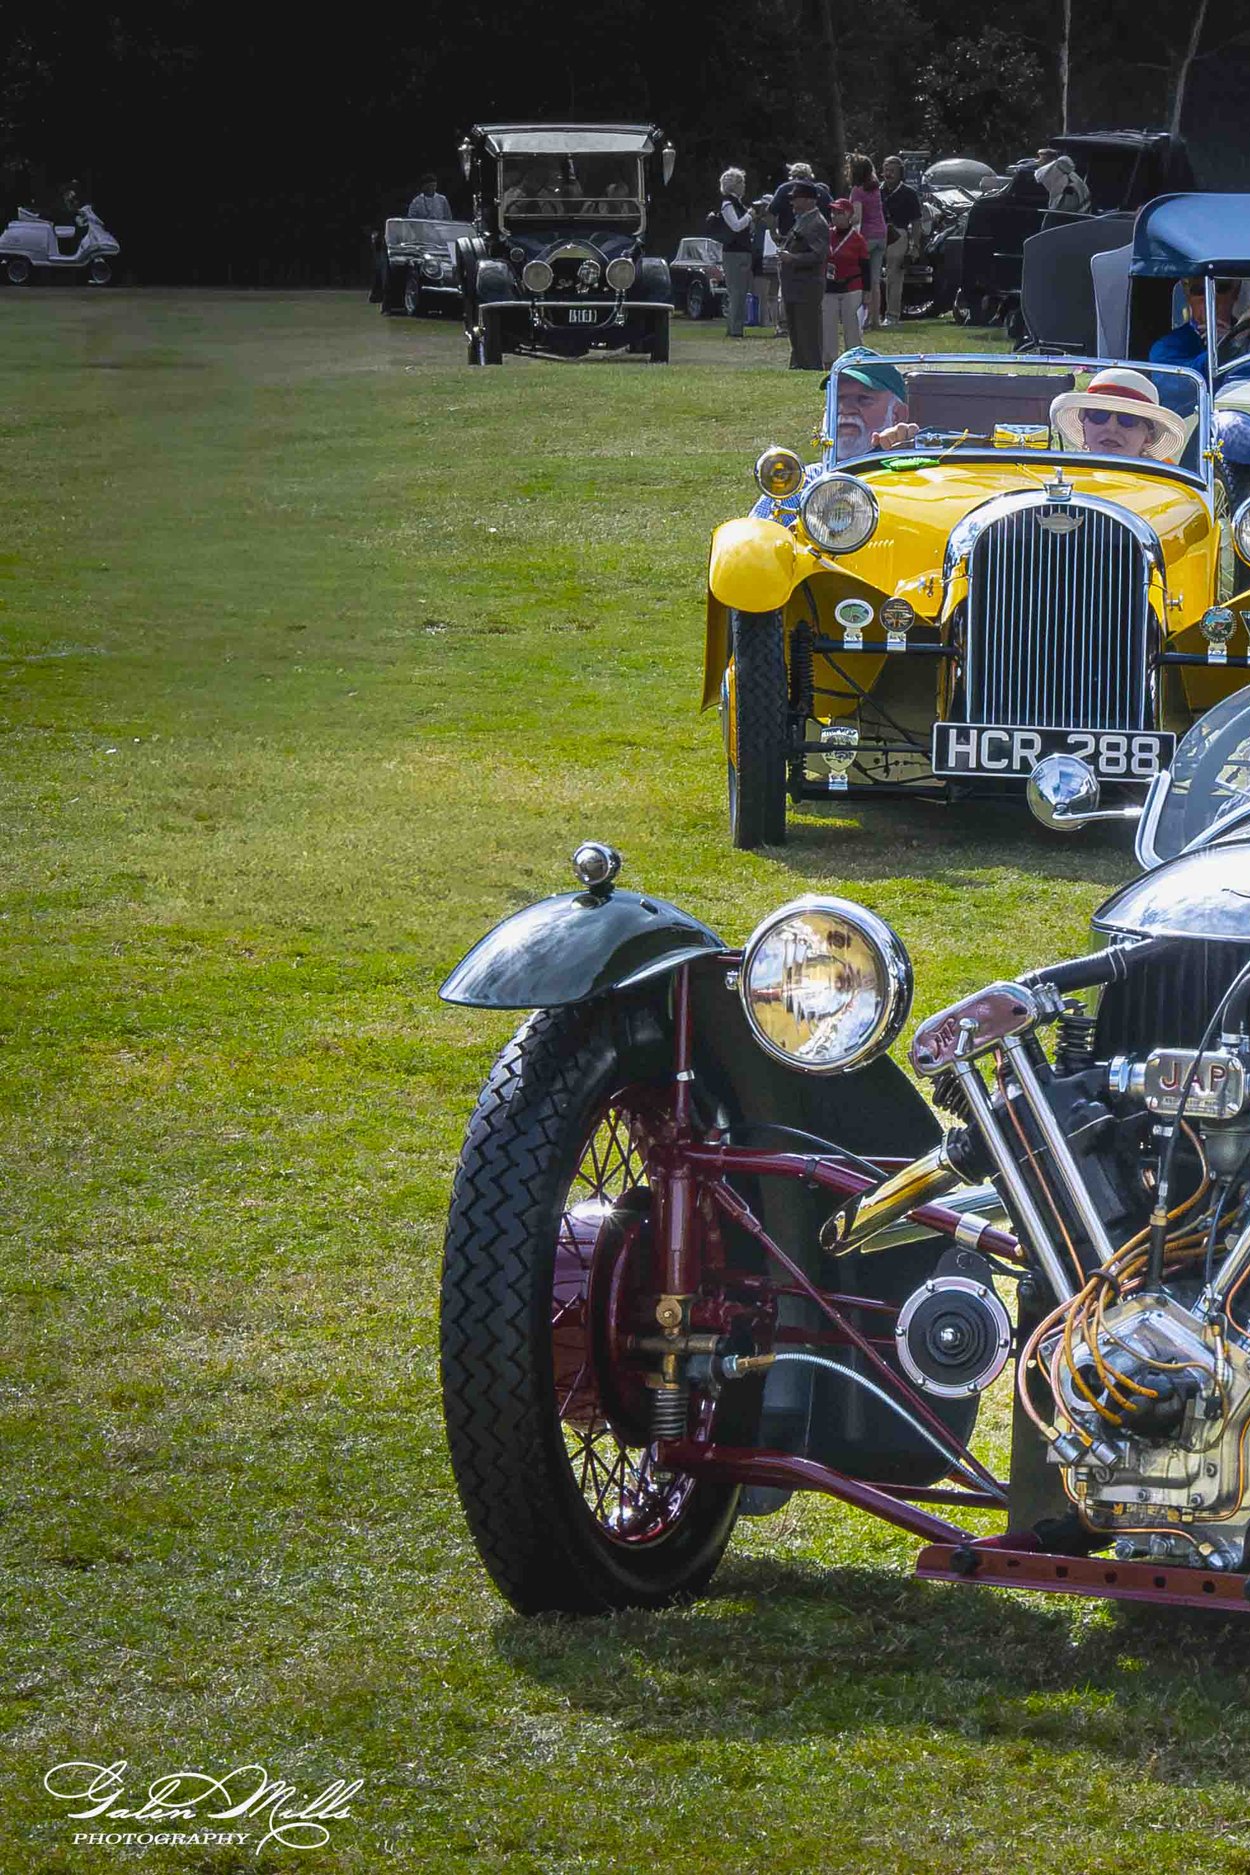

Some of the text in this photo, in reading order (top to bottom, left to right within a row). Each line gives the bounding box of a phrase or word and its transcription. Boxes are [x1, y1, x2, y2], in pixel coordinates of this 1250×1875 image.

[947, 728, 1161, 775] HCR 288
[1160, 1060, 1227, 1093] JAP
